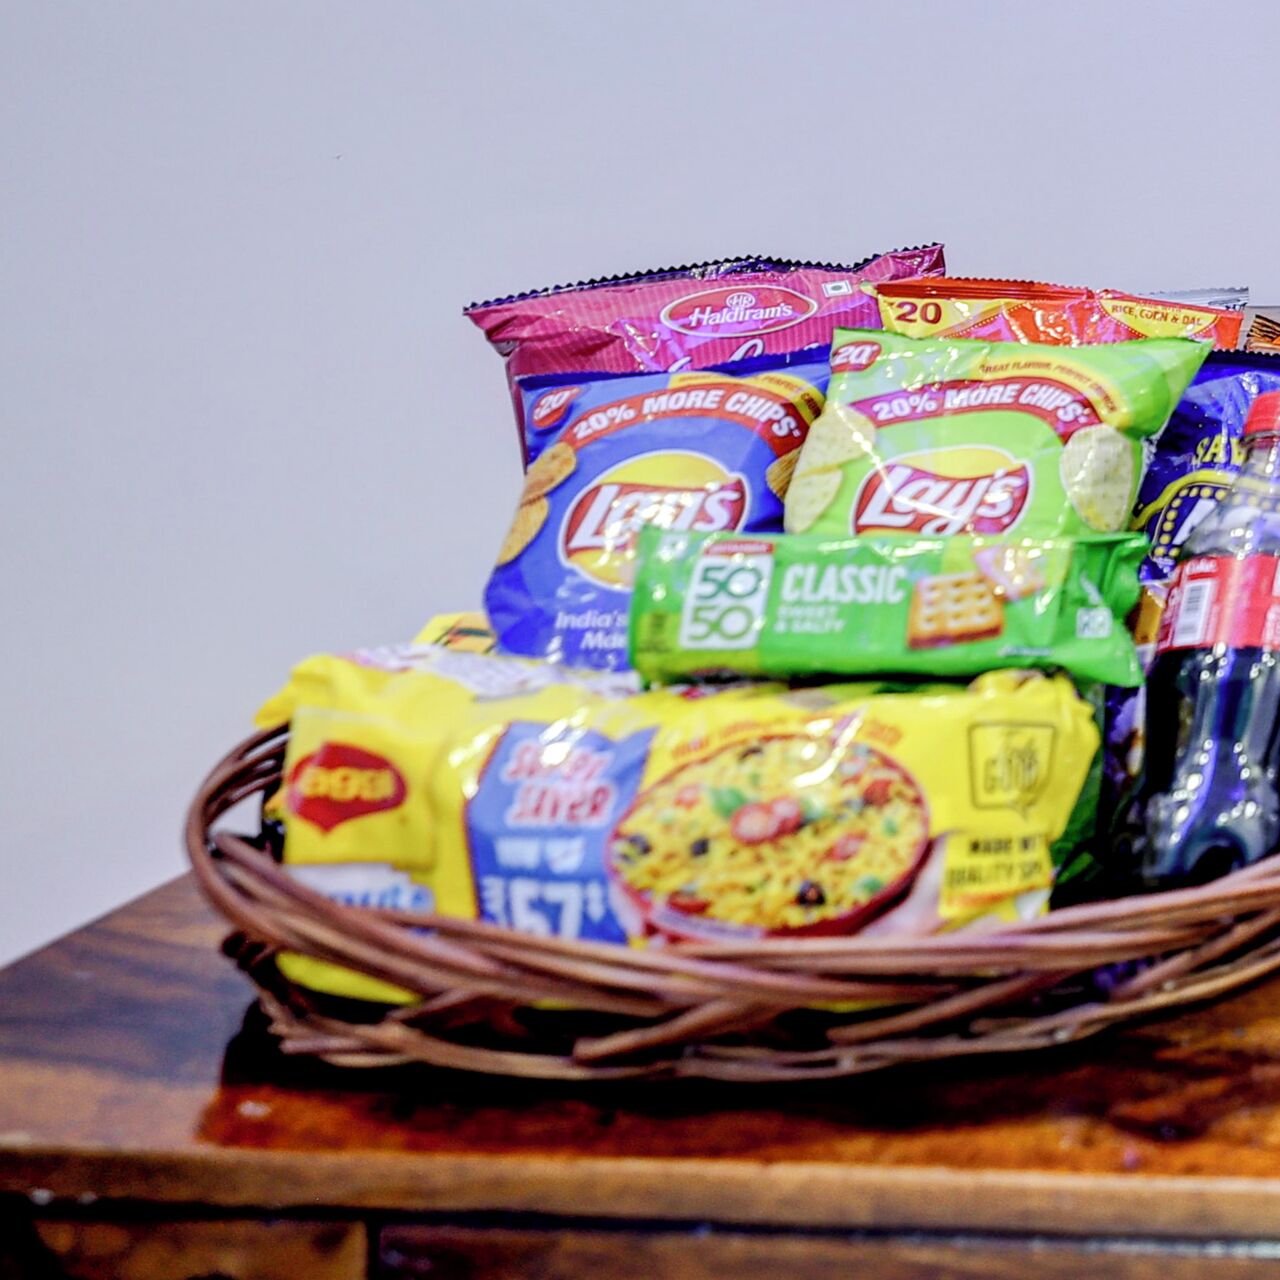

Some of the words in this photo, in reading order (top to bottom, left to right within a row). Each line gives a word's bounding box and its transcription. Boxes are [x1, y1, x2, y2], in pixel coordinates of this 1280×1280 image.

[689, 302, 793, 327] Haldiram's
[1140, 308, 1168, 322] CORN
[573, 404, 637, 439] 20%
[642, 389, 726, 414] MORE
[872, 395, 938, 421] 20%
[943, 382, 1022, 409] MORE
[858, 463, 1026, 536] Lay's
[695, 565, 763, 600] 50
[781, 563, 908, 604] CLASSIC
[555, 609, 629, 629] India's
[688, 604, 753, 641] 50
